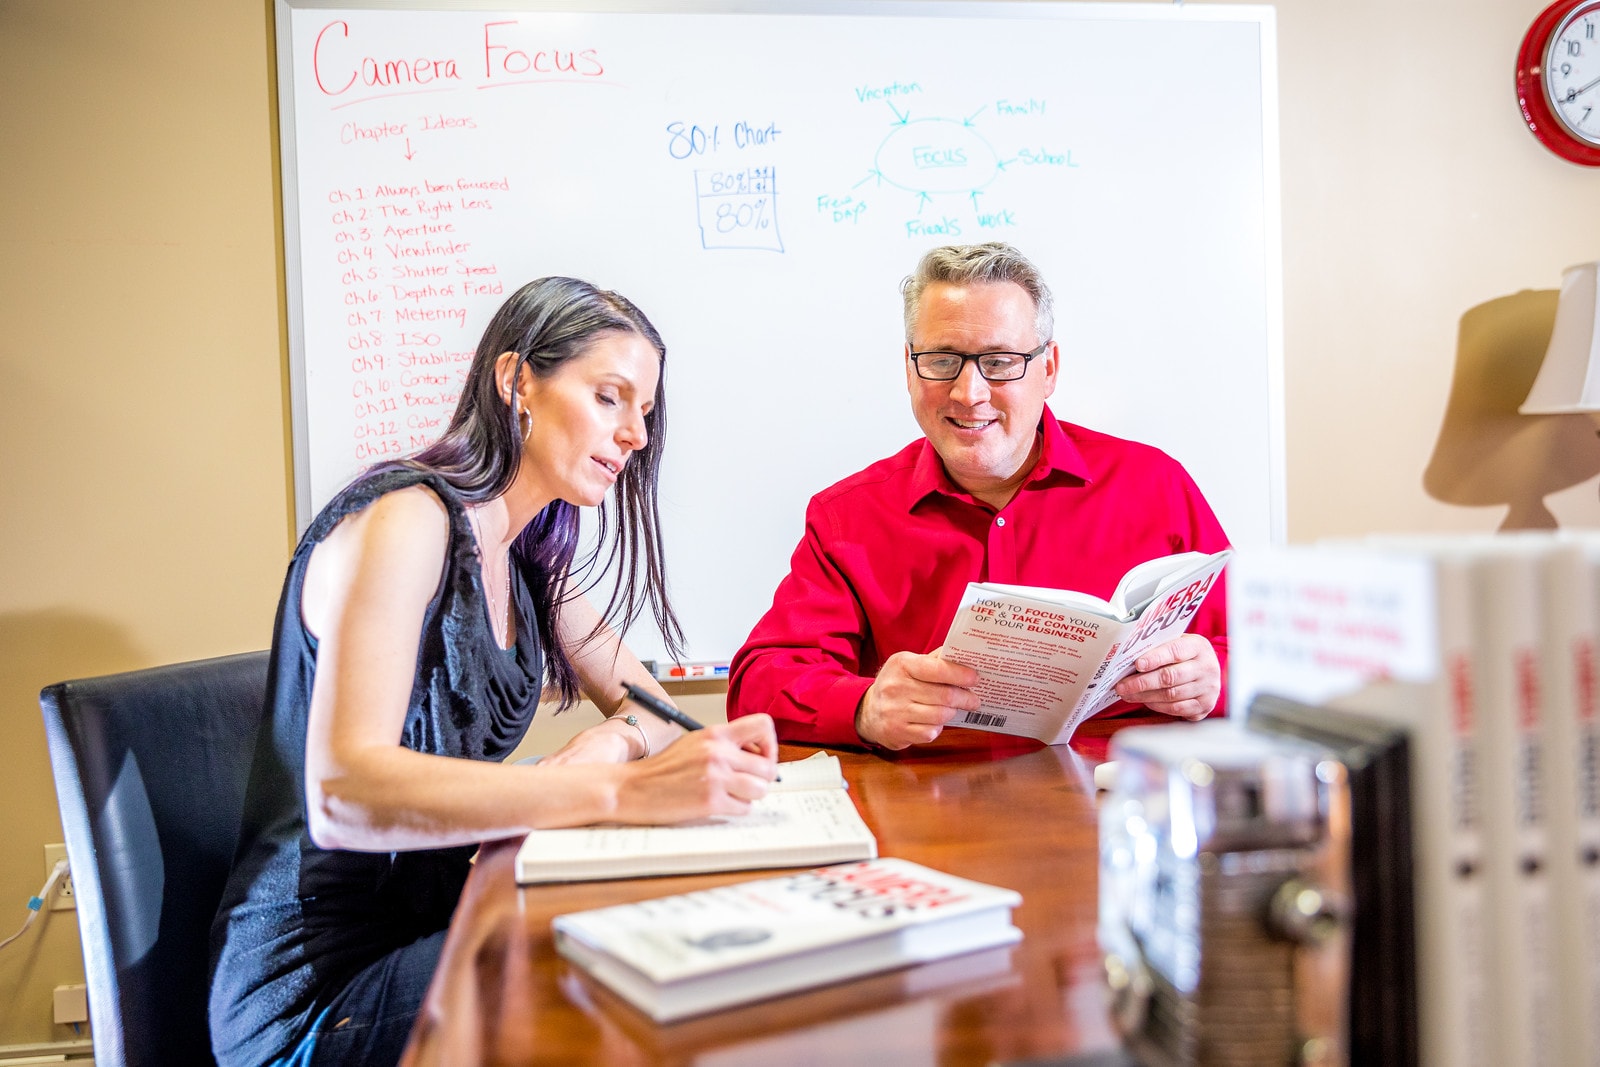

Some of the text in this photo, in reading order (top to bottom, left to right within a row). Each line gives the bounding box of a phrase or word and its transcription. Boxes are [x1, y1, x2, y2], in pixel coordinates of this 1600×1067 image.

[1586, 24, 1595, 39] 11
[313, 20, 604, 96] Camera Focus
[1567, 40, 1580, 57] 10
[1560, 63, 1571, 79] 9
[1583, 106, 1592, 122] 7
[340, 114, 478, 144] Chapter Ideas
[734, 120, 782, 149] Chart
[328, 189, 351, 203] Ch
[375, 185, 420, 198] Always
[332, 210, 354, 225] Ch
[377, 204, 412, 218] The
[416, 199, 453, 220] Right
[461, 197, 493, 210] Lens
[383, 223, 456, 240] Aperture
[337, 248, 360, 264] Ch
[385, 240, 471, 260] Viewfinder
[342, 268, 363, 285] Ch
[392, 265, 449, 279] Shutter
[345, 291, 366, 305] Ch
[386, 284, 438, 303] Depth
[440, 284, 454, 297] of
[463, 280, 503, 297] Field
[347, 312, 368, 327] Ch
[395, 308, 467, 328] Metering
[348, 332, 370, 350] Ch
[395, 332, 441, 347] ISO
[351, 355, 373, 373] Ch
[398, 348, 476, 367] Stabilizat
[352, 380, 373, 398] Ch
[399, 370, 451, 388] Contact
[354, 401, 379, 419] Ch
[403, 391, 461, 407] Bracke
[353, 423, 378, 439] Ch
[407, 415, 441, 430] Color
[355, 441, 379, 460] Ch
[970, 604, 1098, 639] LIFE & TAKE CONTROL
[976, 597, 1100, 631] HOW TO FOCUS YOUR
[1122, 595, 1203, 654] OCUS
[975, 614, 1085, 643] OF YOUR BUSINESS
